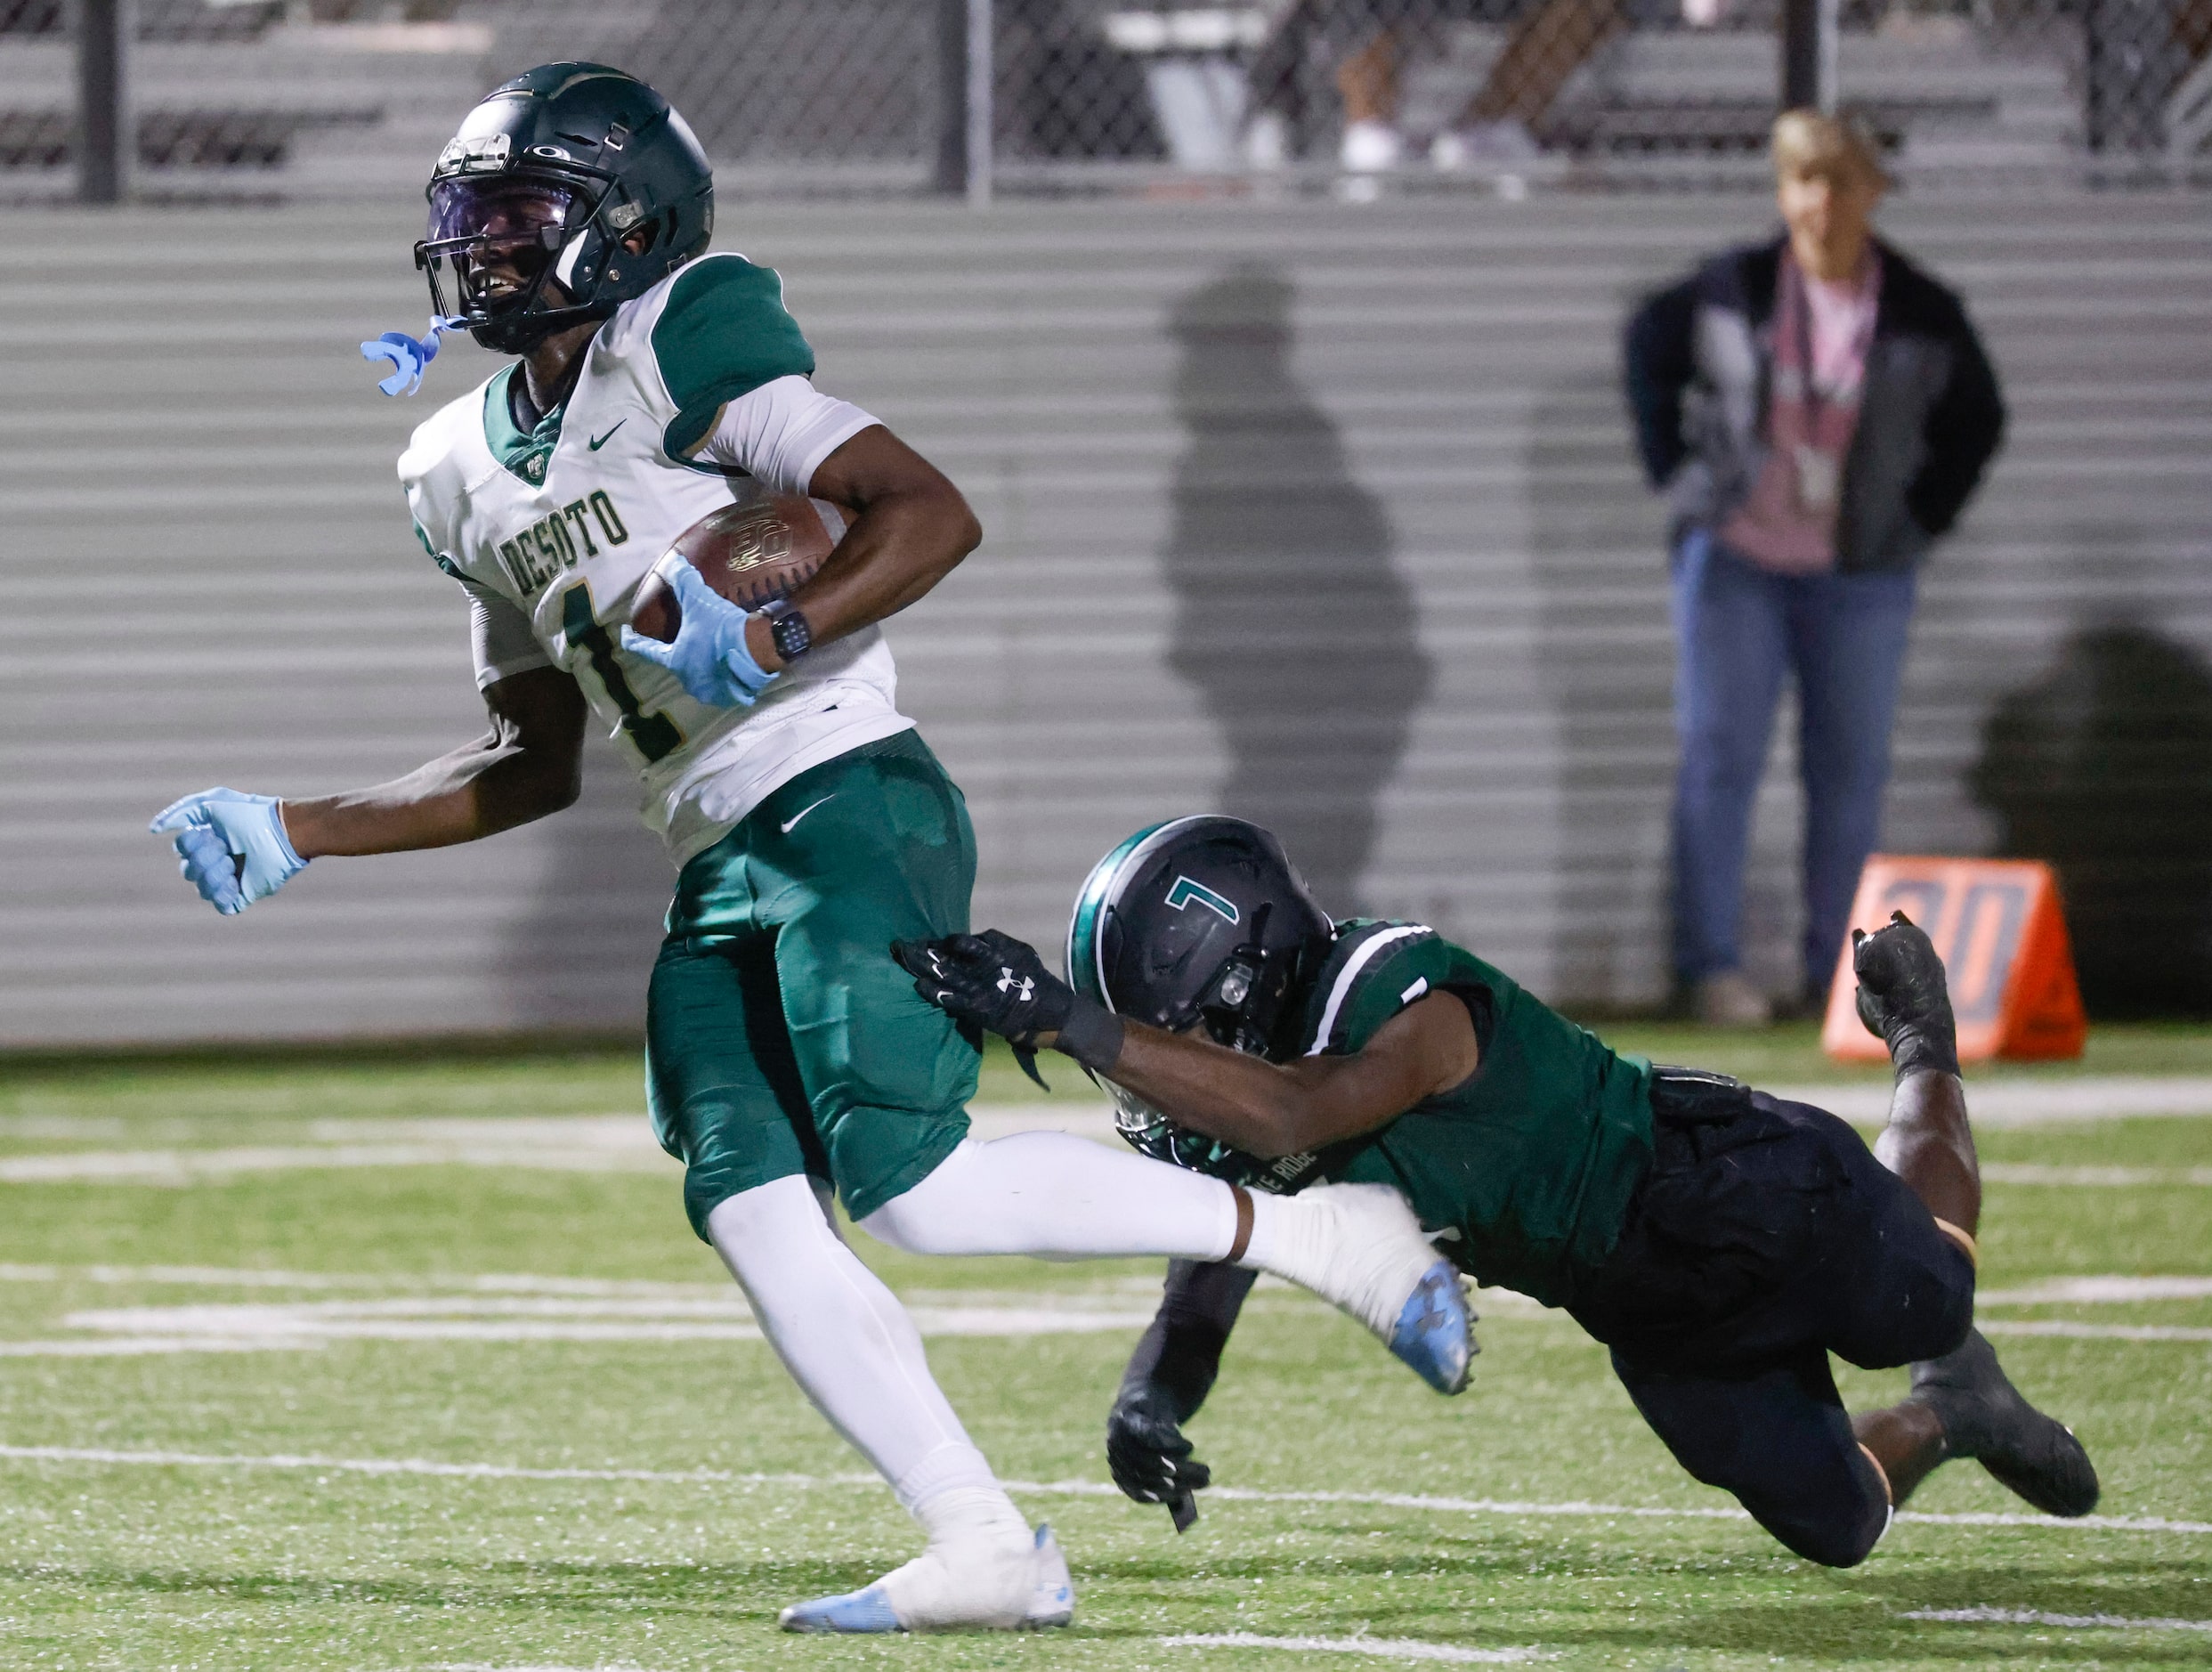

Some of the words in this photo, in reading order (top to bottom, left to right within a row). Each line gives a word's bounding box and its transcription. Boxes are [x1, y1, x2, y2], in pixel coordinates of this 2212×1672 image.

[498, 488, 629, 597] DESOTO
[562, 577, 687, 763] 1
[1163, 874, 1241, 926] 7
